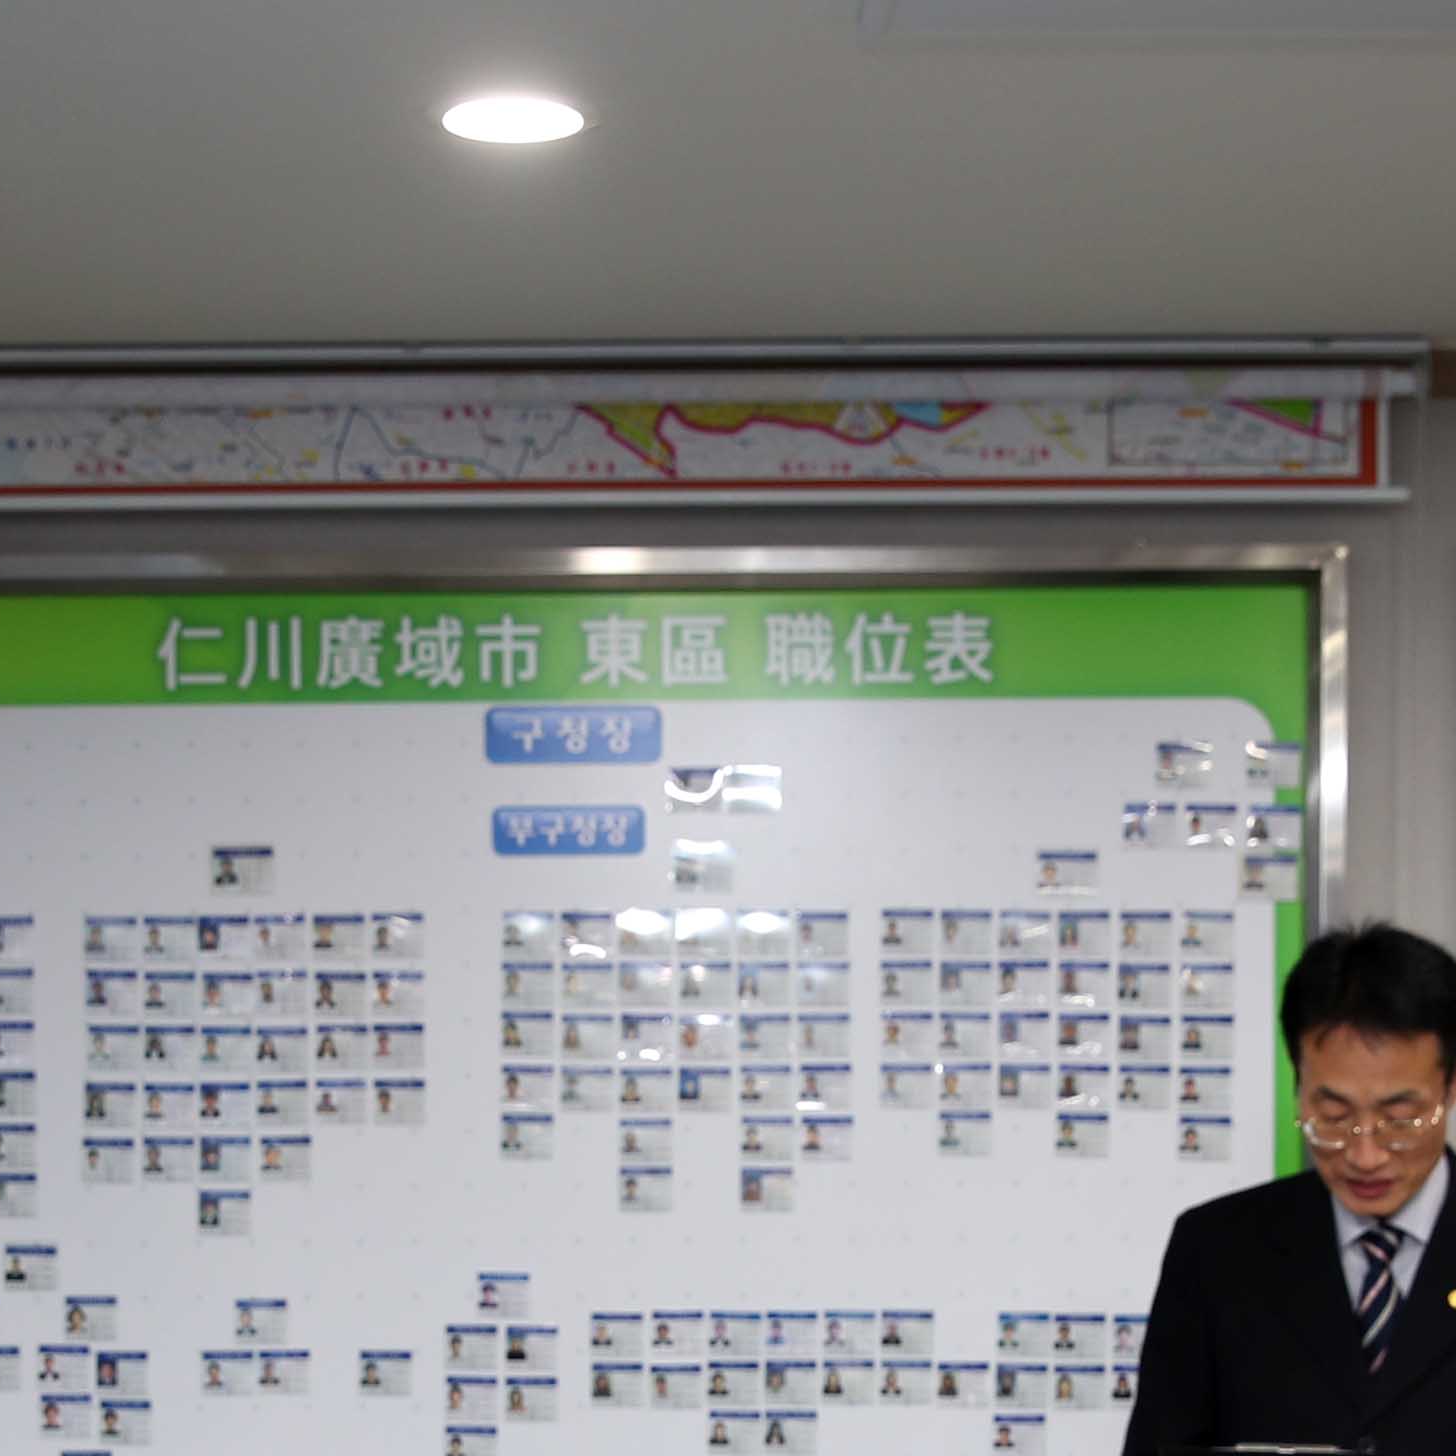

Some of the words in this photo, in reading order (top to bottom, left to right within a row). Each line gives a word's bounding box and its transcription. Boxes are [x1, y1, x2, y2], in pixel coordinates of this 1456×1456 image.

[157, 616, 543, 691] 仁川廣域市
[578, 613, 729, 688] 東區
[764, 612, 996, 687] 職位表
[511, 716, 633, 755] 구청장
